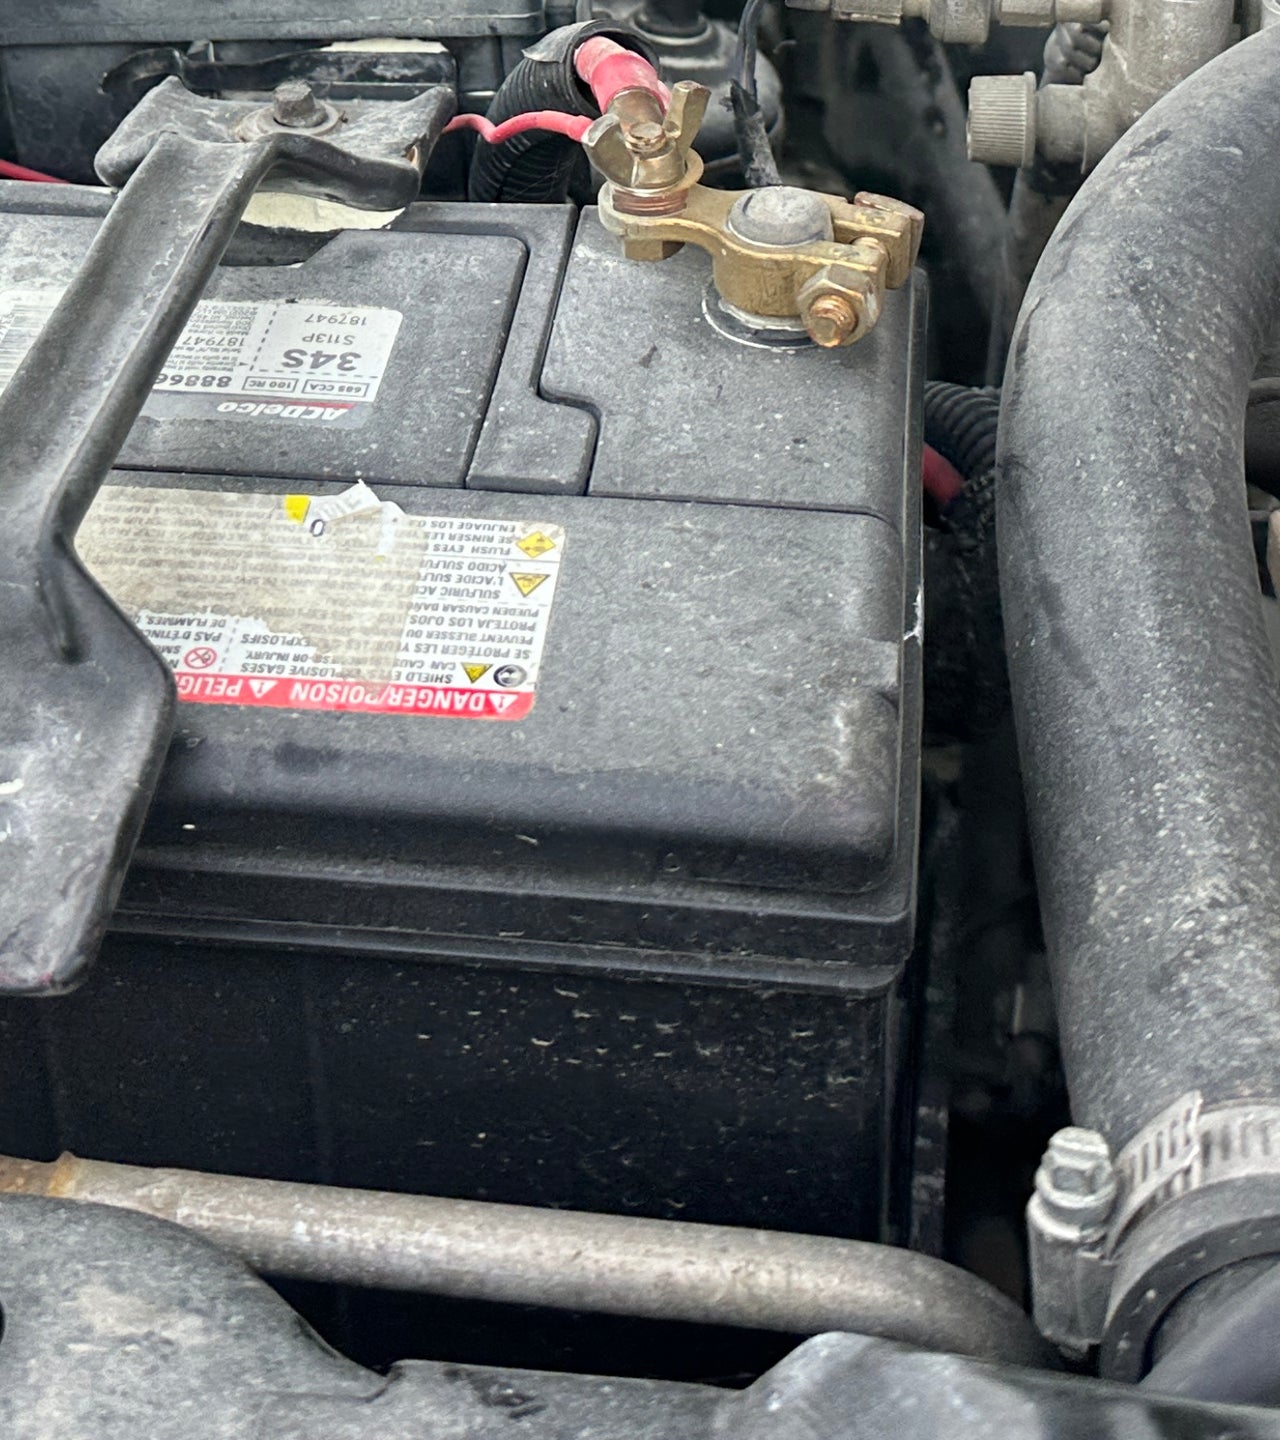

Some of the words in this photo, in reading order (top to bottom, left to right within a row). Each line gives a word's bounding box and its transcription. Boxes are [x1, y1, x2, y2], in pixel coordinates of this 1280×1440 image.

[304, 313, 367, 326] 187947
[182, 336, 245, 347] 187947
[302, 333, 356, 346] S113P
[281, 349, 362, 372] 34S
[154, 373, 232, 388] 88866
[248, 380, 266, 388] RC
[270, 381, 292, 389] 100
[309, 383, 335, 391] CCA
[217, 402, 349, 421] ACDelco
[430, 520, 454, 531] LOS
[457, 520, 516, 533] ENJUAGE
[422, 531, 445, 541] LES
[447, 532, 495, 543] RINSER
[498, 534, 513, 544] SE
[433, 543, 465, 554] EYES
[471, 545, 511, 556] FLUSH
[456, 574, 504, 587] L'ACIDE
[440, 586, 501, 600] SULFURIC
[442, 603, 490, 615] CAUSAR
[492, 607, 539, 618] PUEDEN
[209, 619, 226, 628] DE
[409, 615, 445, 627] OJOS
[448, 616, 474, 628] LOS
[477, 618, 536, 632] PROTEJA
[139, 629, 192, 643] D'ÉTINC
[194, 631, 222, 642] PAS
[240, 633, 311, 647] EXPLOSIFS
[405, 629, 423, 640] OU
[426, 630, 477, 642] BLESSER
[479, 634, 534, 645] PEUVENT
[414, 643, 438, 654] LES
[441, 644, 510, 660] PROTÉGER
[514, 649, 531, 659] SE
[246, 650, 290, 662] INJURY.
[292, 652, 309, 663] OR
[240, 662, 286, 674] GASES
[431, 661, 456, 671] CAN
[405, 671, 454, 684] SHIELD
[175, 675, 243, 697] PELIG
[290, 681, 486, 712] DANGER/POISON
